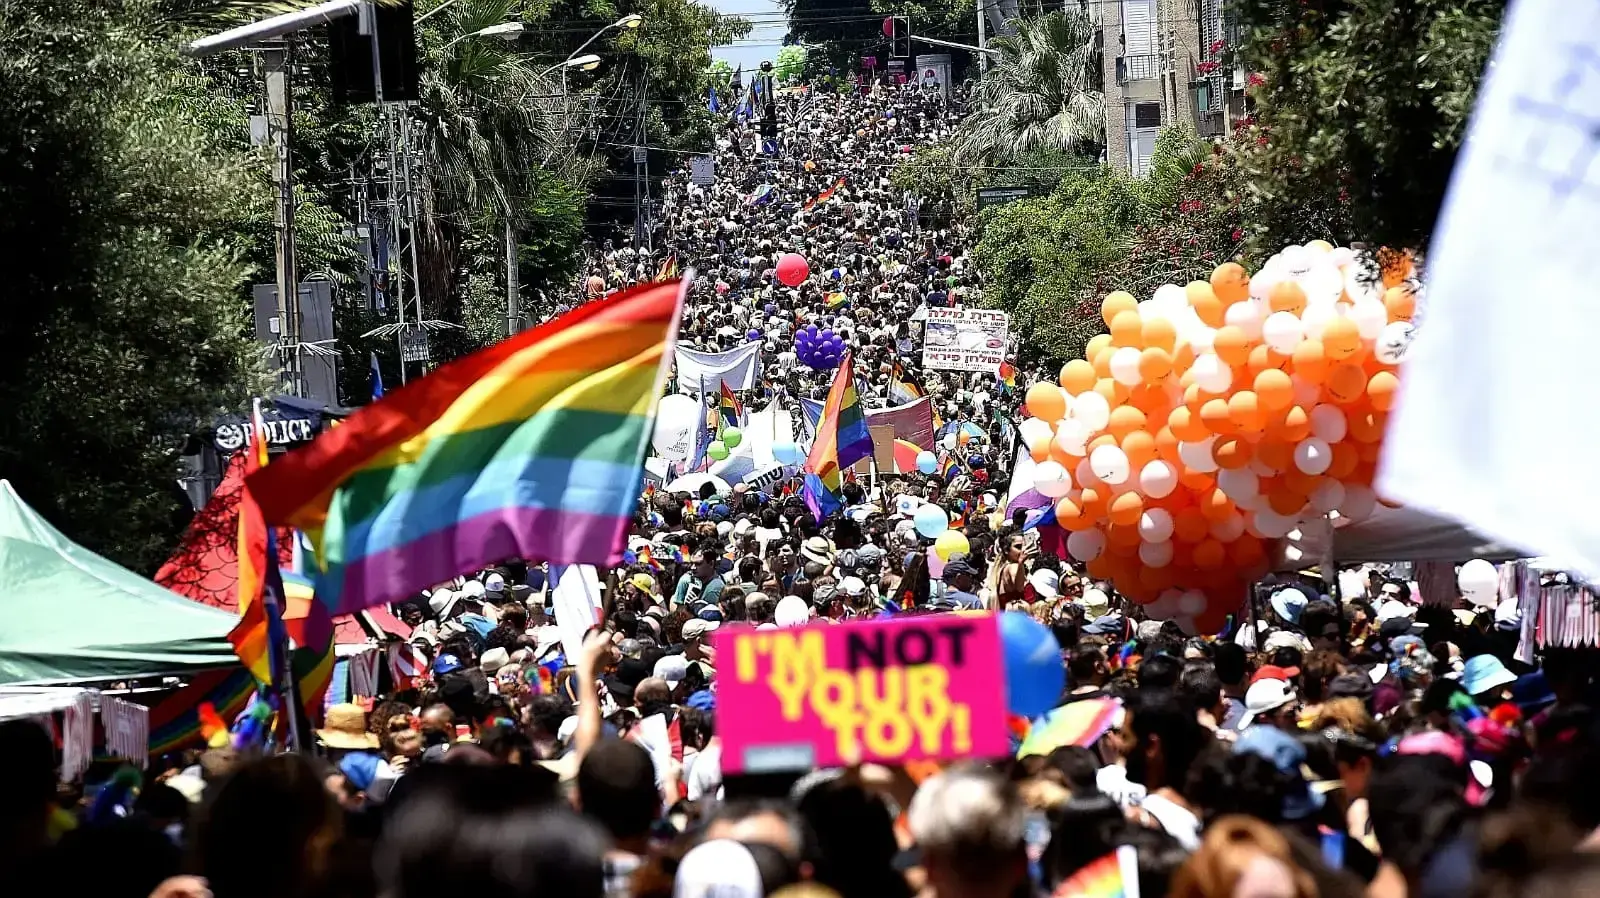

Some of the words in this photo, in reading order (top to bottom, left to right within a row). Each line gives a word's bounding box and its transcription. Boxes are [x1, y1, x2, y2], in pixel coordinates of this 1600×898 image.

[928, 308, 964, 319] מילה
[970, 311, 1005, 322] ברית
[926, 352, 961, 362] פיראי
[965, 353, 1001, 364] פולחן
[735, 631, 826, 683] I'M
[847, 624, 976, 669] NOT
[769, 664, 951, 726] YOUR
[824, 703, 972, 761] TOY!
